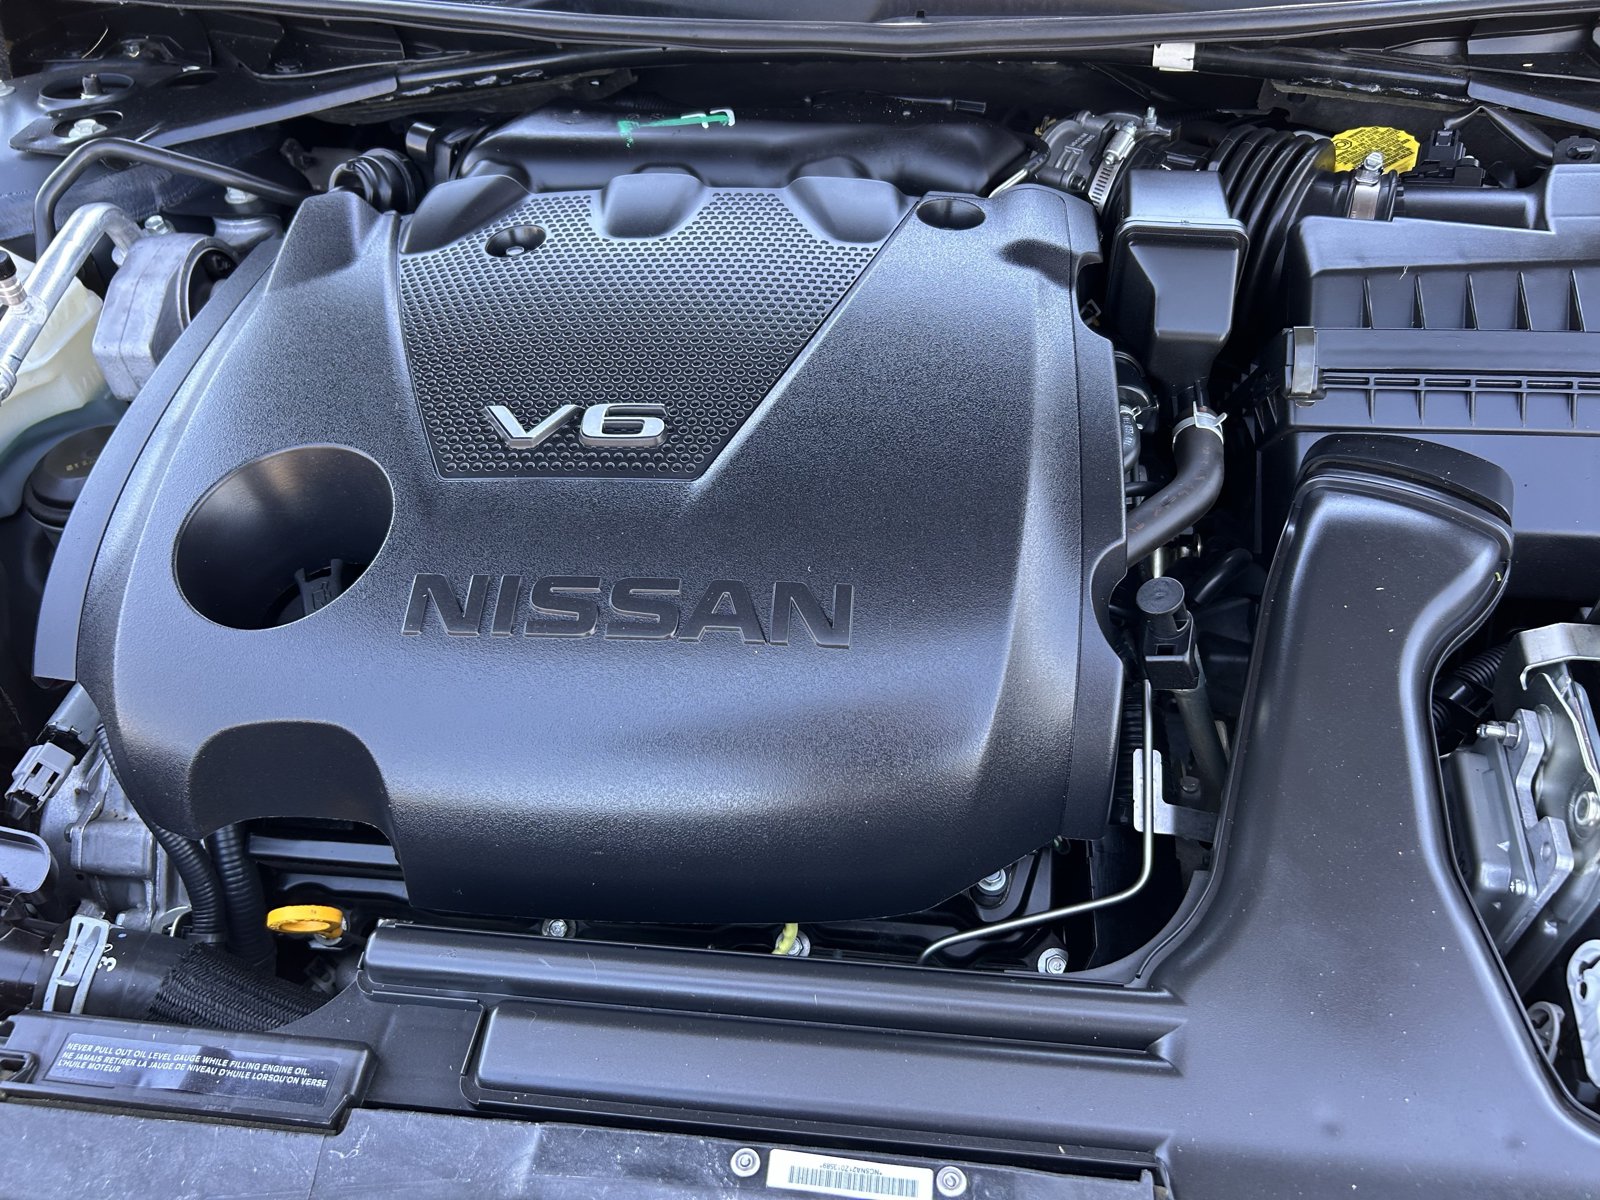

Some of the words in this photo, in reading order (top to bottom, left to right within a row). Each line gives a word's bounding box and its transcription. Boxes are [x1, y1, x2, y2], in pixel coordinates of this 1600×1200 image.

[482, 403, 668, 449] V6
[400, 573, 855, 649] NISSAN
[57, 1059, 88, 1069] L'HUILE
[87, 1063, 122, 1073] MOTEUR.
[62, 1052, 74, 1060] NE
[74, 1052, 103, 1062] JAMAIS
[104, 1056, 137, 1066] RETIRER
[137, 1059, 148, 1067] LA
[147, 1060, 173, 1070] JAUGE
[174, 1062, 186, 1071] DE
[186, 1064, 218, 1075] NIVEAU
[219, 1068, 251, 1080] D'HUILE
[251, 1072, 300, 1084] LORSQU'ON
[301, 1077, 328, 1087] VERSE
[66, 1043, 92, 1052] NEVER
[93, 1045, 112, 1054] PULL
[115, 1048, 133, 1056] OUT
[133, 1050, 146, 1058] OIL
[148, 1051, 171, 1060] LEVEL
[173, 1054, 201, 1063] GAUGE
[202, 1055, 229, 1066] WHILE
[230, 1059, 260, 1070] FILLING
[261, 1063, 293, 1074] ENGINE
[294, 1067, 310, 1076] OIL.
